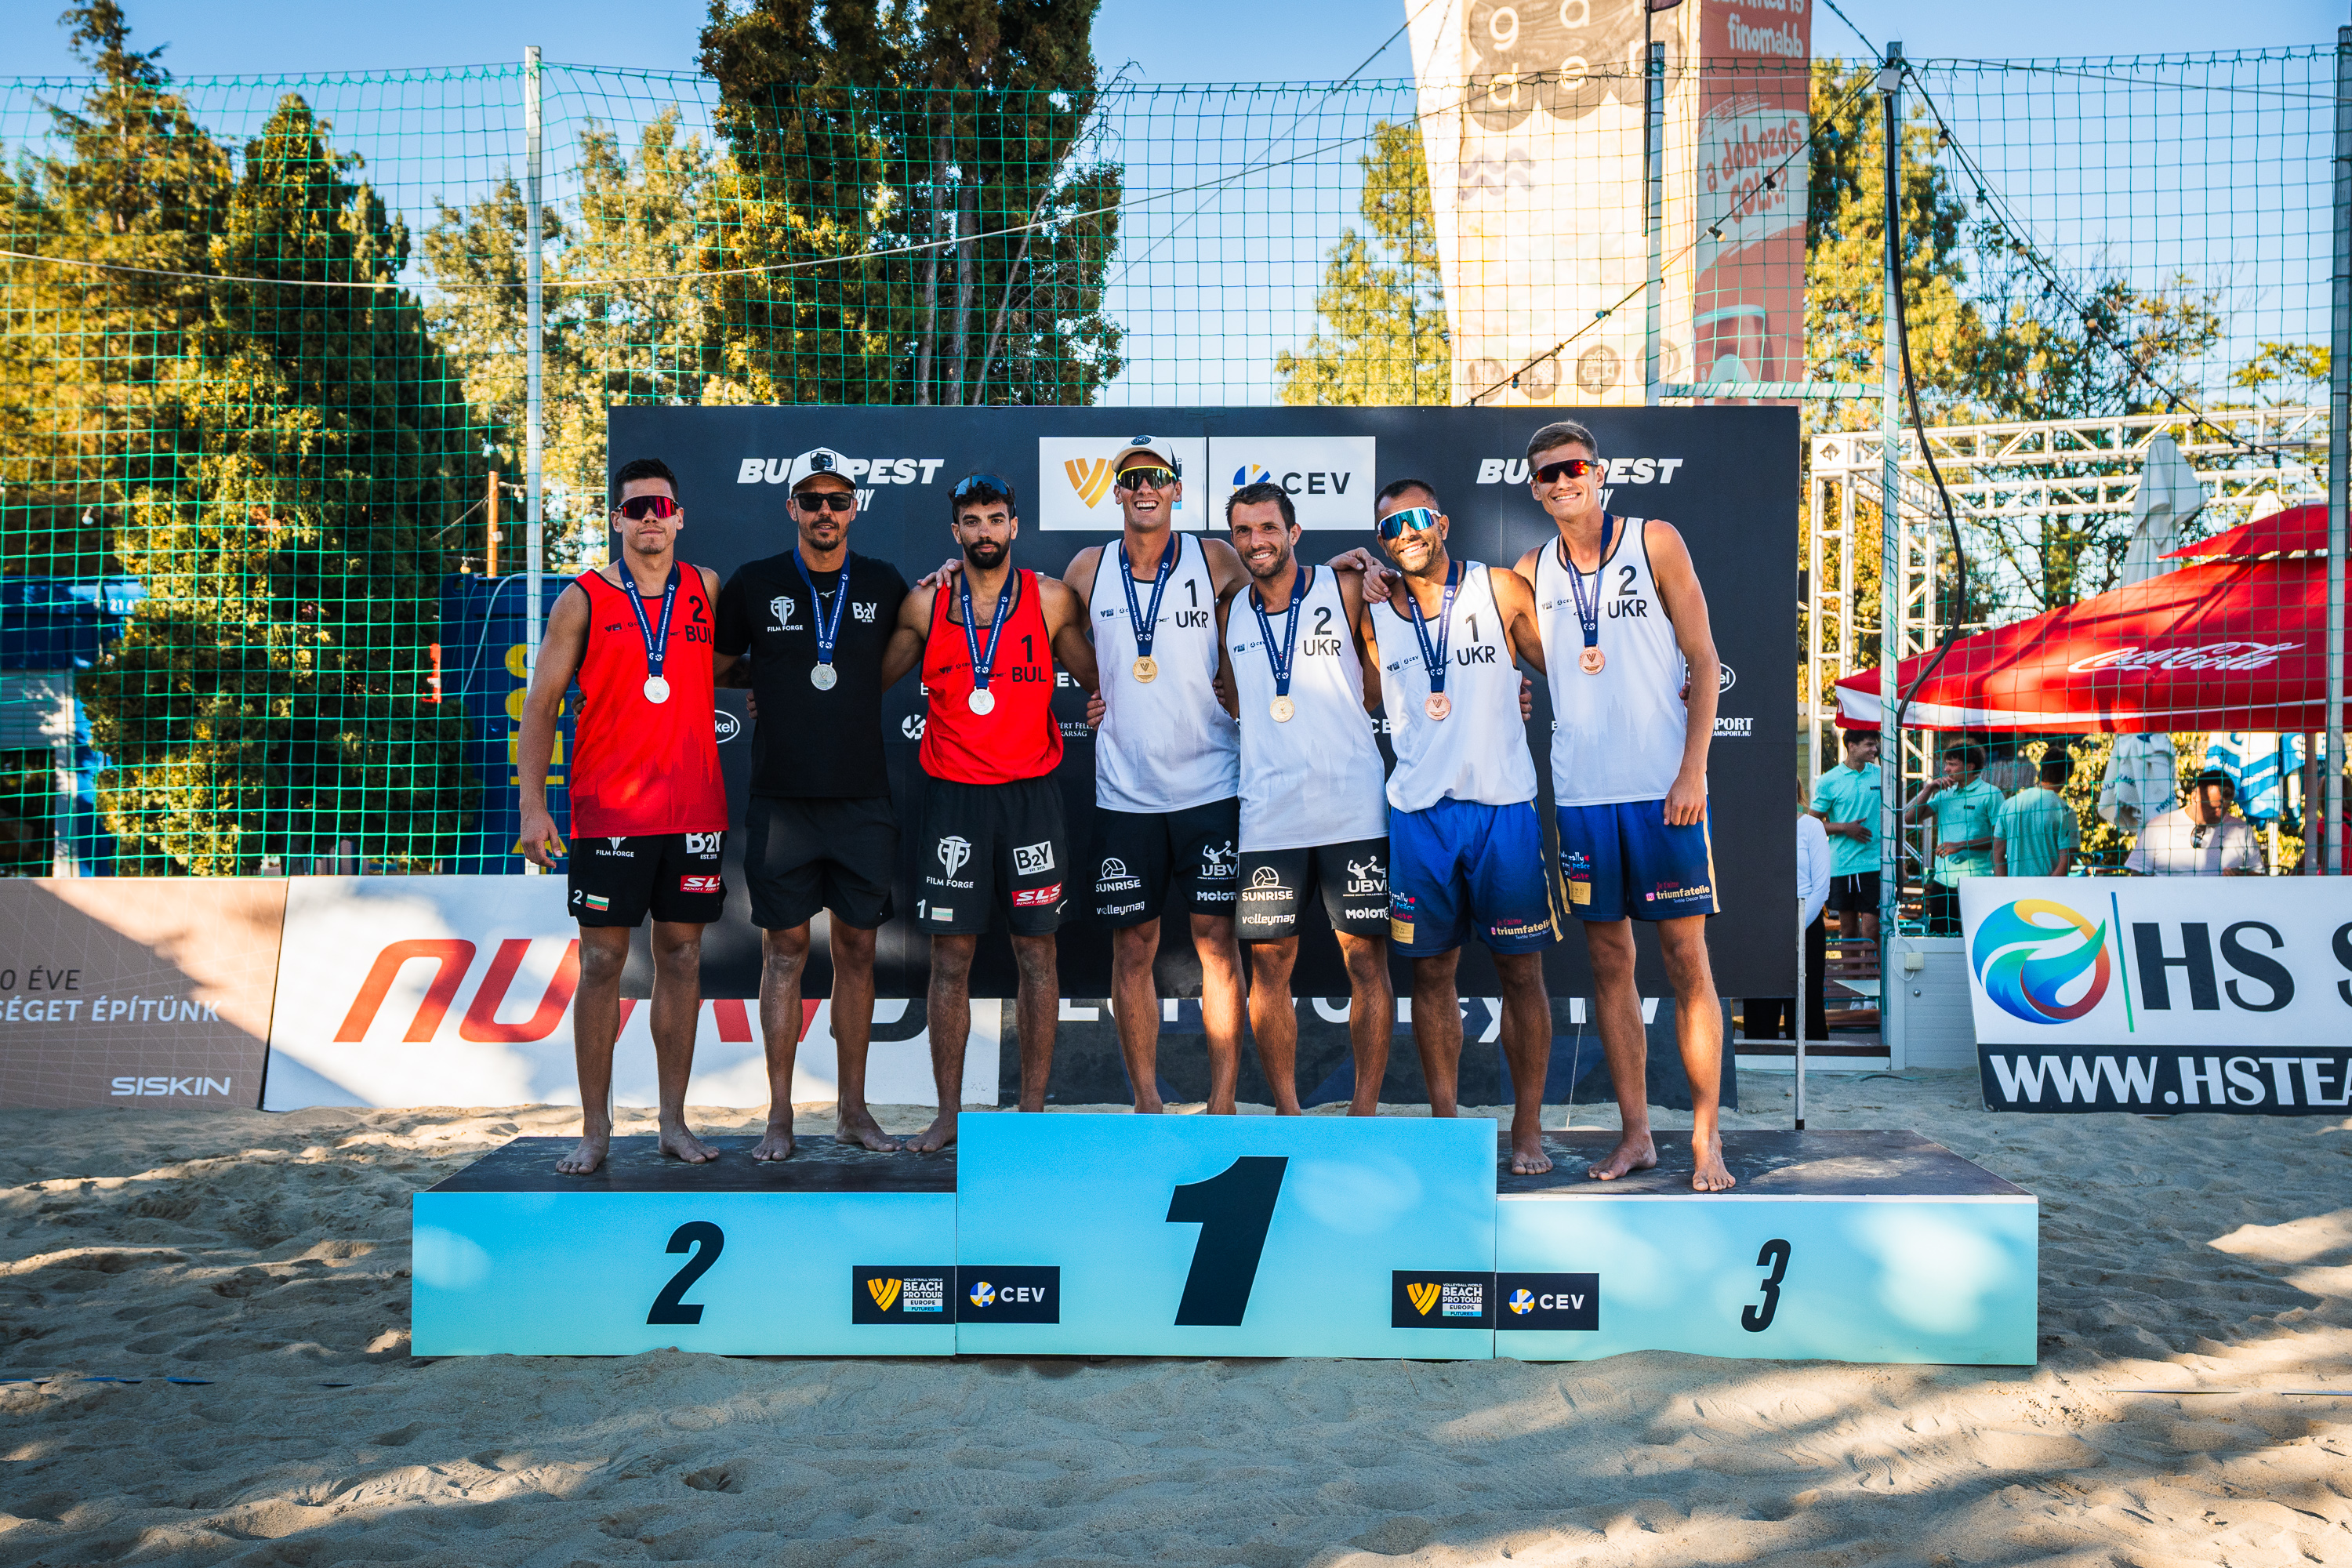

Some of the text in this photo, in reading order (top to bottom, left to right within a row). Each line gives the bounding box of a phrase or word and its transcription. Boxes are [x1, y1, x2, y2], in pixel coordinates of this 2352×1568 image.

[1727, 13, 1803, 58] finomabb
[1722, 118, 1802, 180] dobozos
[737, 458, 944, 485] BUPEST
[1476, 458, 1683, 485] BUEST
[1282, 472, 1351, 495] CEV
[1618, 565, 1637, 596] 2
[1185, 579, 1197, 607] 1
[689, 595, 707, 624] 2
[852, 602, 877, 619] B2Y
[1608, 599, 1647, 619] UKR
[1176, 611, 1208, 628] UKR
[1314, 607, 1332, 635] 2
[1465, 613, 1479, 642] 1
[1021, 634, 1033, 662] 1
[1304, 639, 1341, 656] UKR
[1457, 646, 1496, 666] UKR
[1012, 666, 1047, 683] BUL
[1714, 717, 1754, 731] PORT
[1016, 844, 1051, 869] B2Y
[926, 876, 974, 888] FILM FORGE
[1095, 879, 1142, 892] SUNRISE
[1657, 884, 1710, 900] triumfatelie
[572, 889, 583, 905] 2
[1242, 890, 1294, 902] SUNRISE
[916, 899, 926, 919] 1
[1097, 901, 1145, 915] volleymag
[1242, 913, 1295, 926] volleymag
[2132, 920, 2296, 1012] HS
[28, 965, 81, 990] ÉVE
[0, 995, 221, 1022] ÉGET ÉPÍTÜNK
[111, 1076, 230, 1096] SISKIN
[1165, 1156, 1289, 1327] 1
[646, 1221, 724, 1324] 2
[903, 1282, 942, 1291] BEACH
[1000, 1287, 1045, 1302] CEV
[1443, 1287, 1482, 1296] BEACH
[1741, 1239, 1791, 1332] 3
[1539, 1294, 1584, 1309] CEV
